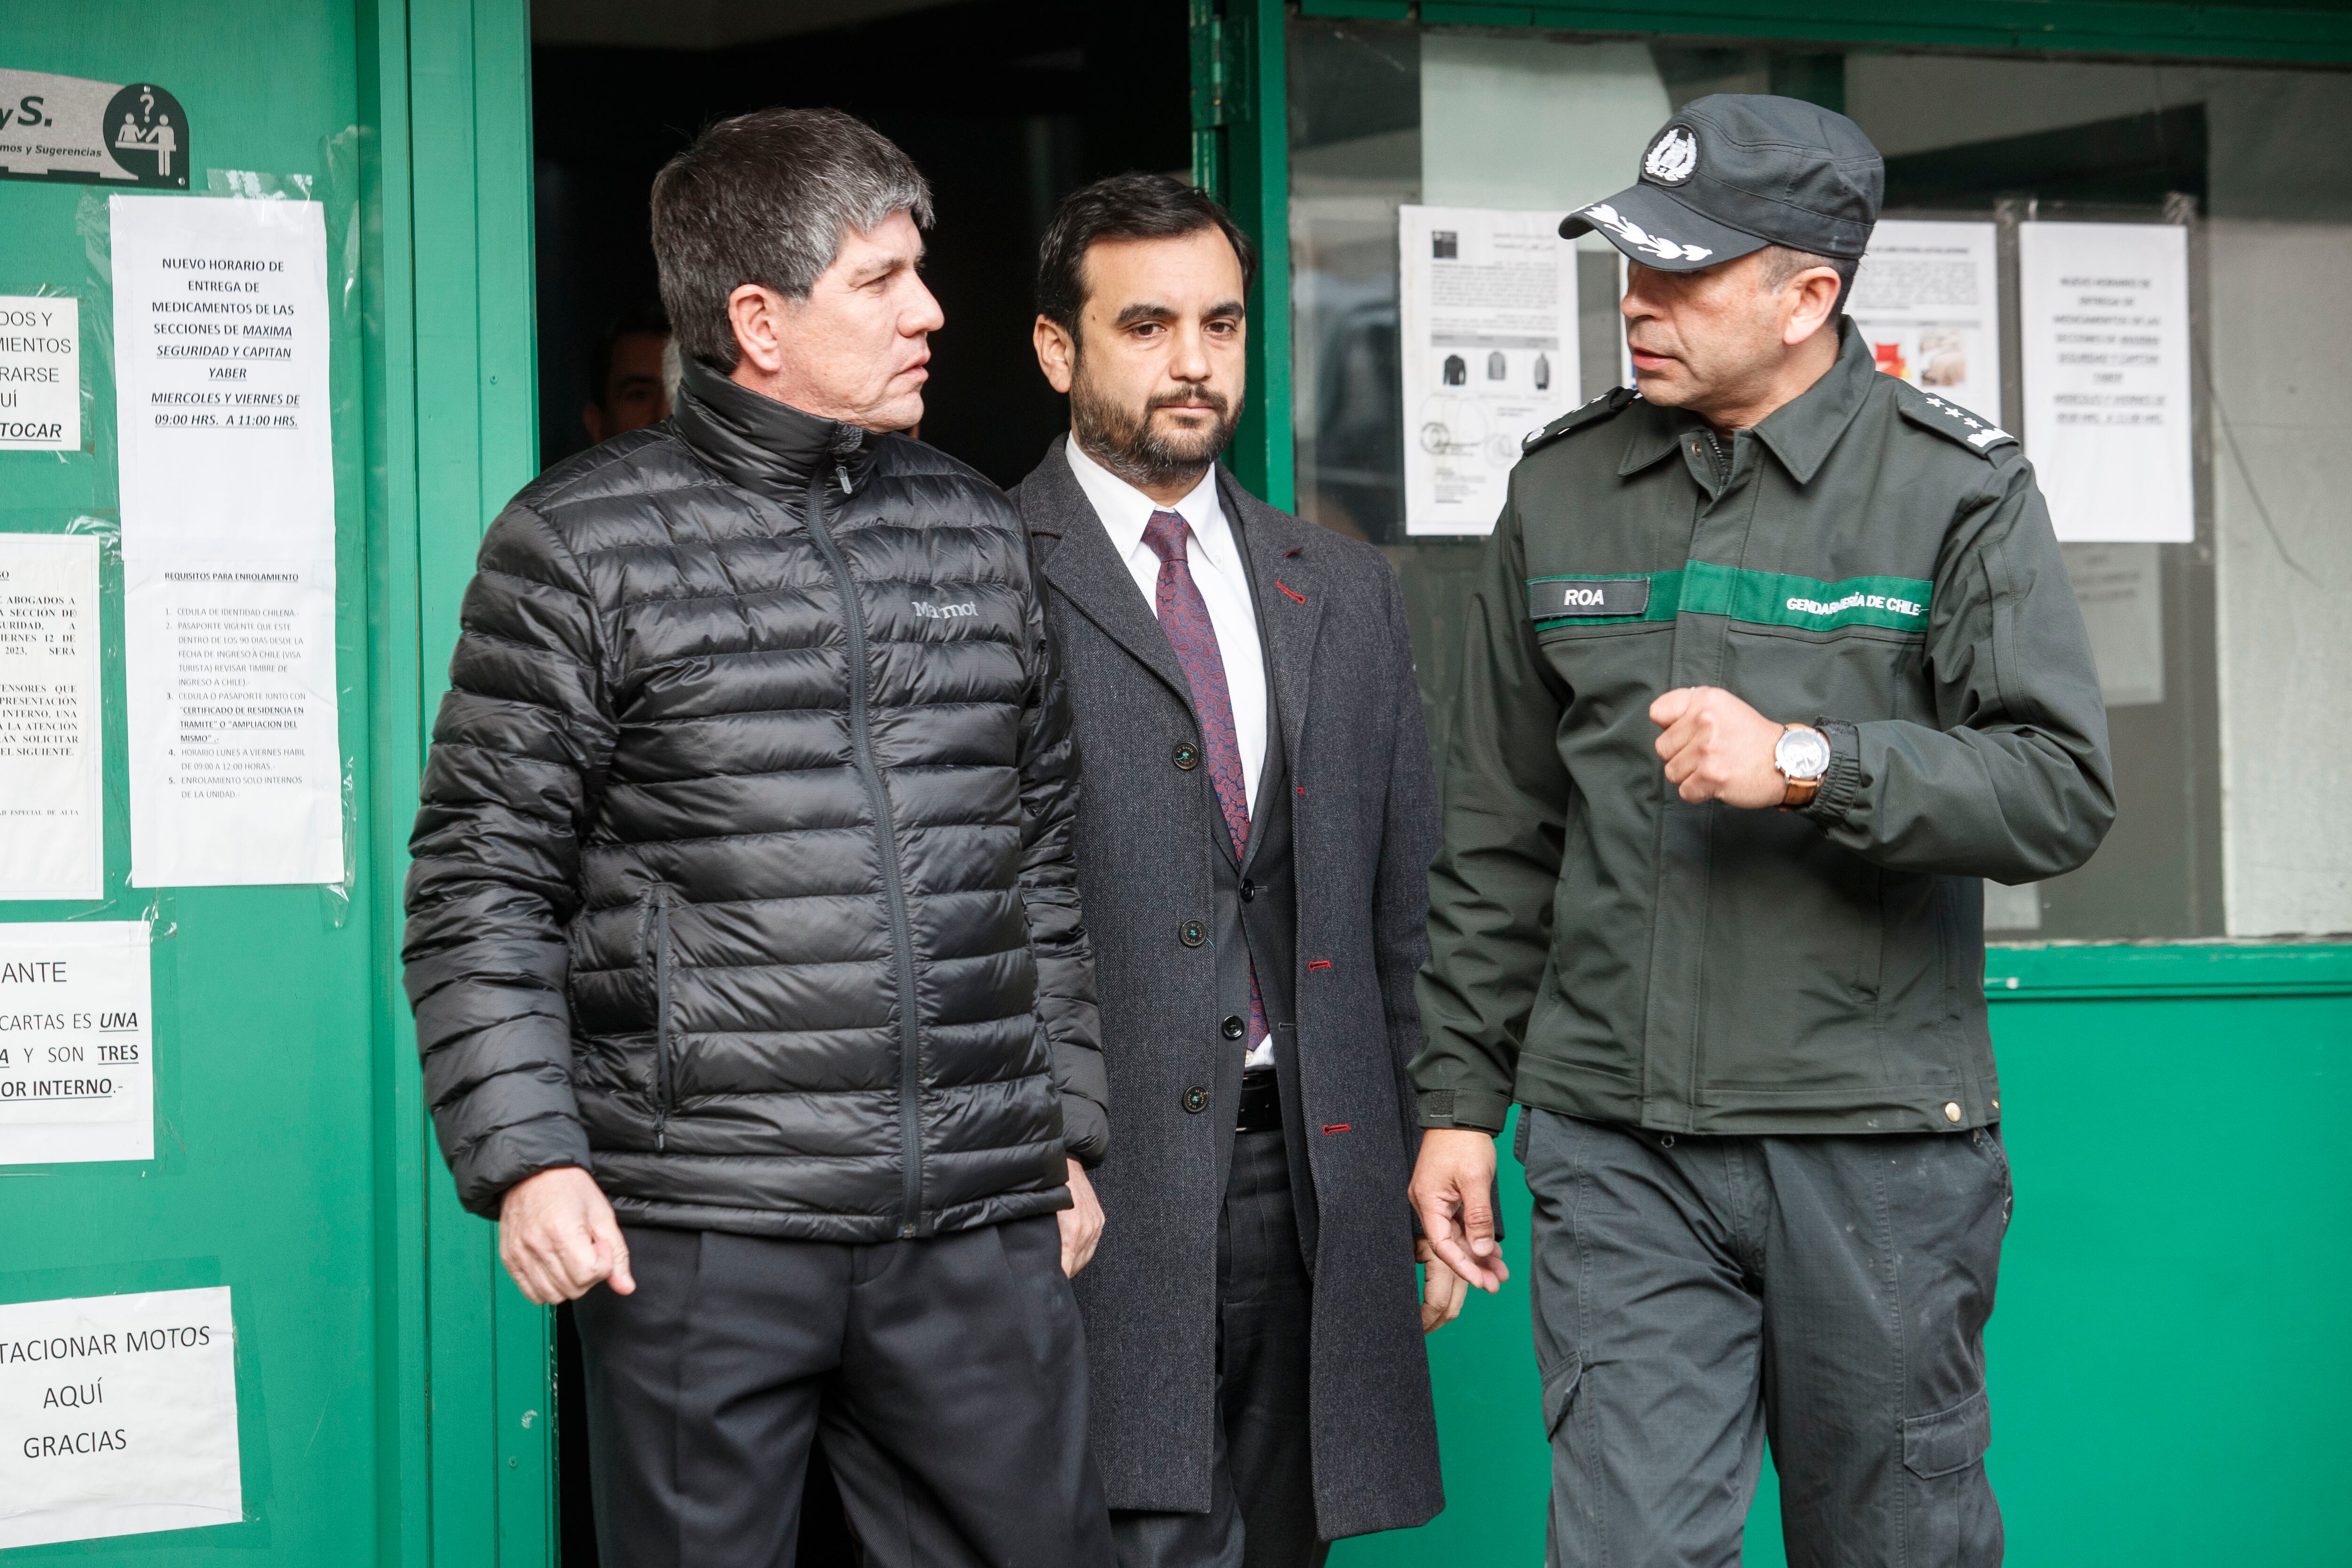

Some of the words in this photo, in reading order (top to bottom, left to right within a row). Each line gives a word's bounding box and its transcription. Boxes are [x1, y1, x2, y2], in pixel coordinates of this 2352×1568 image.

[26, 146, 32, 156] y
[35, 145, 102, 157] Sugerencias
[163, 258, 206, 270] NUEVO
[210, 259, 265, 271] HORARIO
[270, 261, 284, 272] DE
[189, 280, 241, 292] ENTREGA
[245, 282, 259, 293] DE
[152, 302, 252, 314] MEDICAMENTOS
[256, 304, 270, 315] DE
[274, 304, 294, 316] LAS
[41, 312, 52, 326] Y
[154, 324, 220, 335] SECCIONES
[224, 325, 238, 335] DE
[243, 325, 292, 337] MAXIMA
[0, 337, 71, 353] IENTOS
[157, 345, 229, 357] SEGURIDAD
[233, 346, 239, 358] Y
[243, 346, 291, 359] CAPITAN
[209, 367, 246, 379] YABER
[151, 393, 221, 404] MIERCOLES
[225, 393, 231, 404] Y
[236, 393, 283, 406] VIERNES
[286, 394, 300, 406] DE
[155, 414, 187, 425] 09:00
[191, 414, 218, 426] HRS.
[226, 414, 233, 426] A
[238, 415, 270, 426] 11:00
[274, 415, 297, 427] HRS.
[0, 422, 62, 438] TOCAR
[165, 572, 210, 581] REQUISITOS
[213, 573, 233, 582] PARA
[236, 573, 298, 582] ENROLAMIENTO
[7, 596, 64, 605] ABOGADOS
[1564, 589, 1604, 605] ROA
[1866, 595, 1886, 609] DE
[10, 606, 55, 617] SECCIÓN
[178, 607, 207, 616] CEDULA
[222, 608, 260, 617] IDENTIDAD
[178, 621, 222, 630] PASAPORTE
[224, 622, 255, 630] VIGENTE
[257, 622, 272, 632] QUE
[275, 622, 291, 631] ESTE
[63, 634, 75, 643] DE
[178, 636, 208, 645] DENTRO
[251, 636, 268, 645] DIAS
[269, 636, 292, 645] DESDE
[295, 637, 303, 645] LA
[6, 646, 27, 656] 2023,
[49, 644, 75, 655] SERÁ
[179, 650, 202, 659] FECHA
[217, 650, 250, 659] INGRESO
[253, 650, 257, 659] A
[260, 650, 280, 659] CHILE
[283, 651, 301, 660] (VISA
[179, 664, 213, 674] TURISTA)
[215, 664, 247, 672] REVISAR
[249, 664, 276, 674] TIMBRE
[278, 664, 287, 673] DE
[179, 677, 212, 686] INGRESO
[0, 684, 46, 692] ENSORES
[55, 685, 77, 694] QUE
[3, 709, 50, 718] INTERNO,
[236, 707, 245, 715] DE
[248, 707, 292, 715] RESIDENCIA
[294, 707, 303, 715] EN
[26, 720, 77, 731] ATENCIÓN
[220, 721, 225, 729] O
[284, 720, 297, 729] DEL
[23, 735, 78, 743] SOLICITAR
[17, 748, 74, 756] SIGUIENTE.
[250, 748, 281, 756] VIERNES
[284, 748, 305, 756] HABIL
[194, 762, 213, 771] 09:00
[243, 776, 262, 785] SOLO
[265, 776, 303, 784] INTERNOS
[1, 962, 67, 983] ANTE
[0, 1014, 64, 1031] CARTAS
[74, 1013, 91, 1028] ES
[100, 1012, 137, 1028] UNA
[24, 1048, 33, 1063] Y
[48, 1046, 83, 1062] SON
[97, 1045, 138, 1061] TRES
[1, 1082, 26, 1097] OR
[0, 1334, 117, 1364] TACIONAR
[127, 1326, 209, 1353] MOTOS
[43, 1377, 102, 1409] AQUÍ
[24, 1429, 126, 1458] GRACIAS
